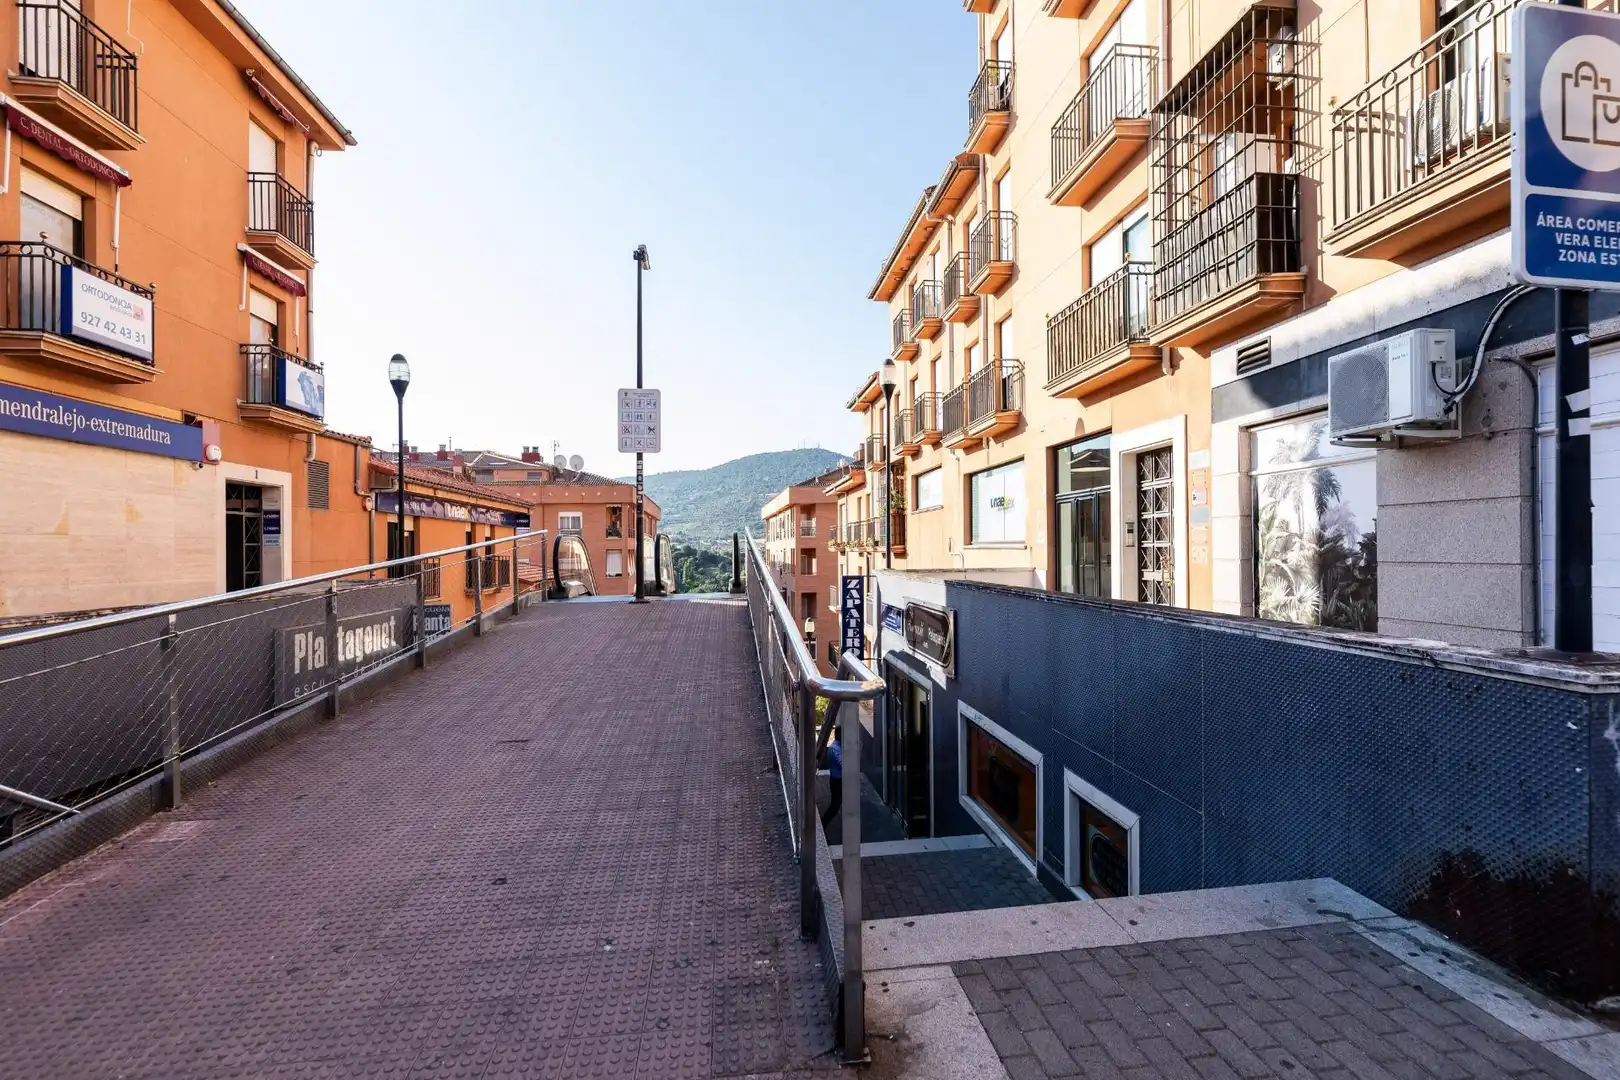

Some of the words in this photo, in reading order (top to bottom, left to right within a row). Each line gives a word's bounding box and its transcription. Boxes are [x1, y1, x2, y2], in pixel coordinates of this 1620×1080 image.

[31, 122, 64, 150] DENTAL
[69, 145, 121, 181] ORTODONCIA
[1537, 211, 1573, 229] ÁREA
[1555, 232, 1590, 247] VERA
[1594, 235, 1620, 249] ELE
[1558, 249, 1597, 264] ZONA
[81, 284, 132, 309] ORTODONCIA
[81, 311, 101, 328] 927
[104, 320, 117, 335] 42
[120, 326, 132, 340] 43
[135, 331, 146, 345] 31
[412, 614, 451, 632] Panta
[845, 579, 861, 657] ZAPATERO
[294, 615, 397, 675] Platagenet
[294, 672, 346, 697] escua
